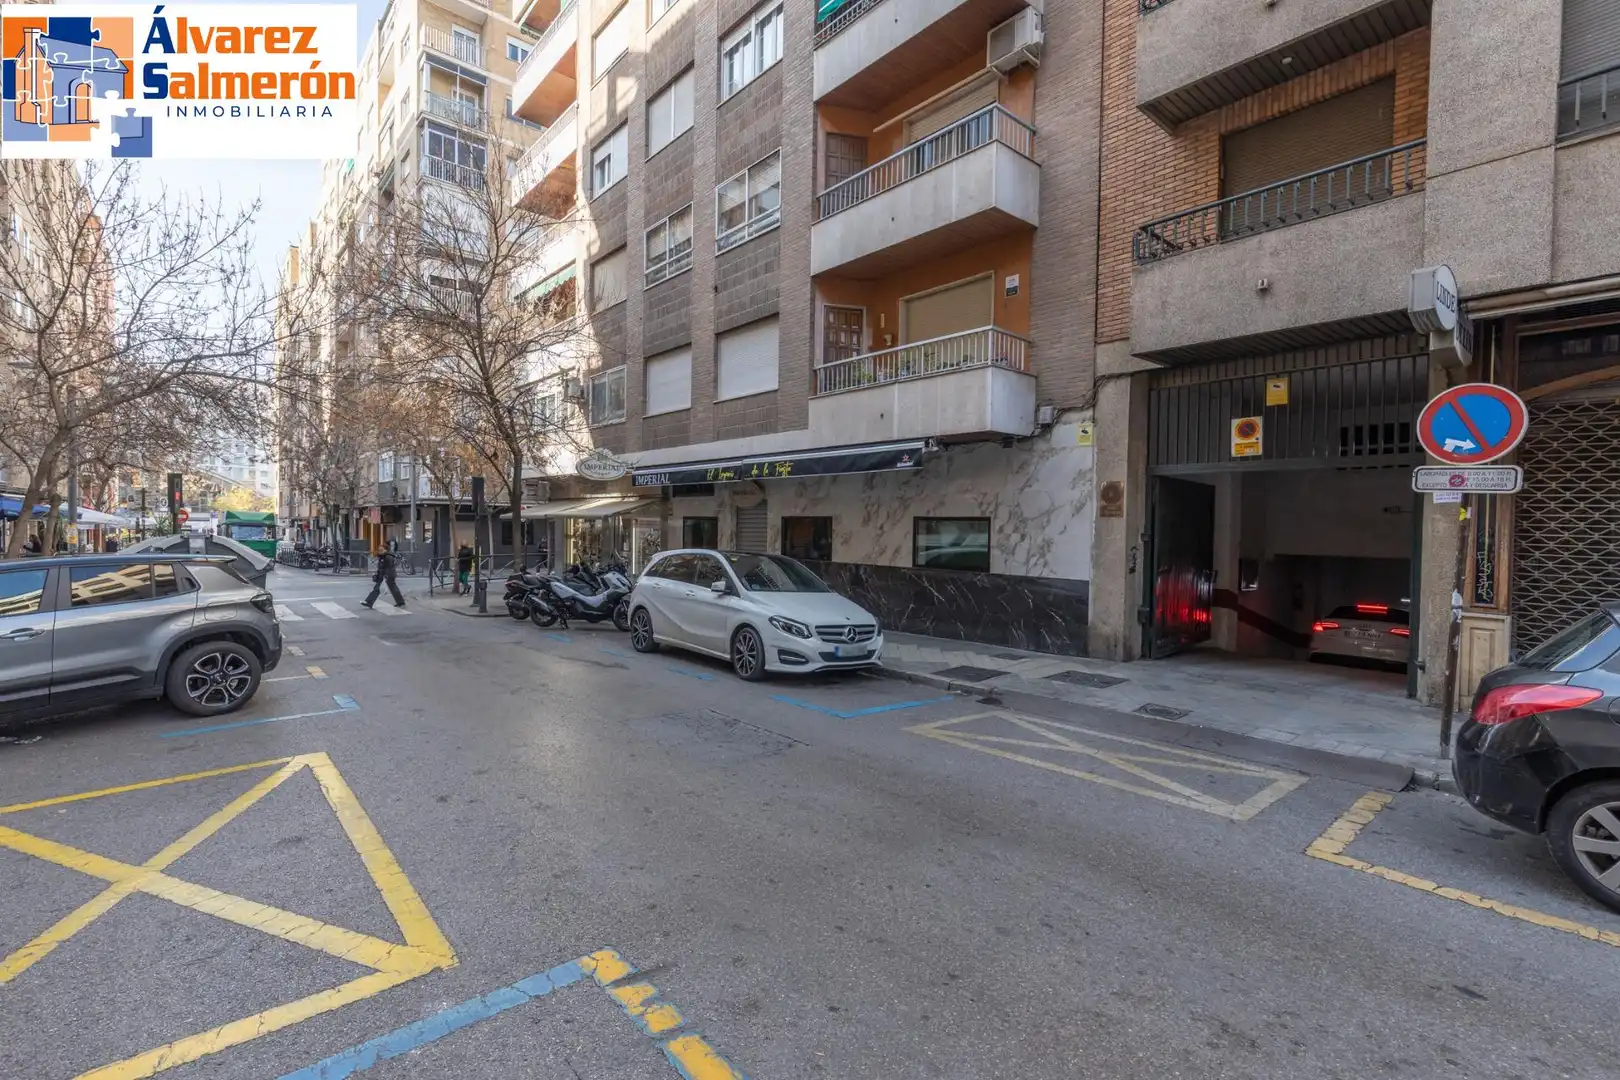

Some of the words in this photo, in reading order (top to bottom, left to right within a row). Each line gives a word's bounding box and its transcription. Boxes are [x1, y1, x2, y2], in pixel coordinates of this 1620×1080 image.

[1436, 280, 1456, 313] LINDE
[584, 463, 621, 472] IMPERIAL
[636, 473, 671, 486] IMPERIAL
